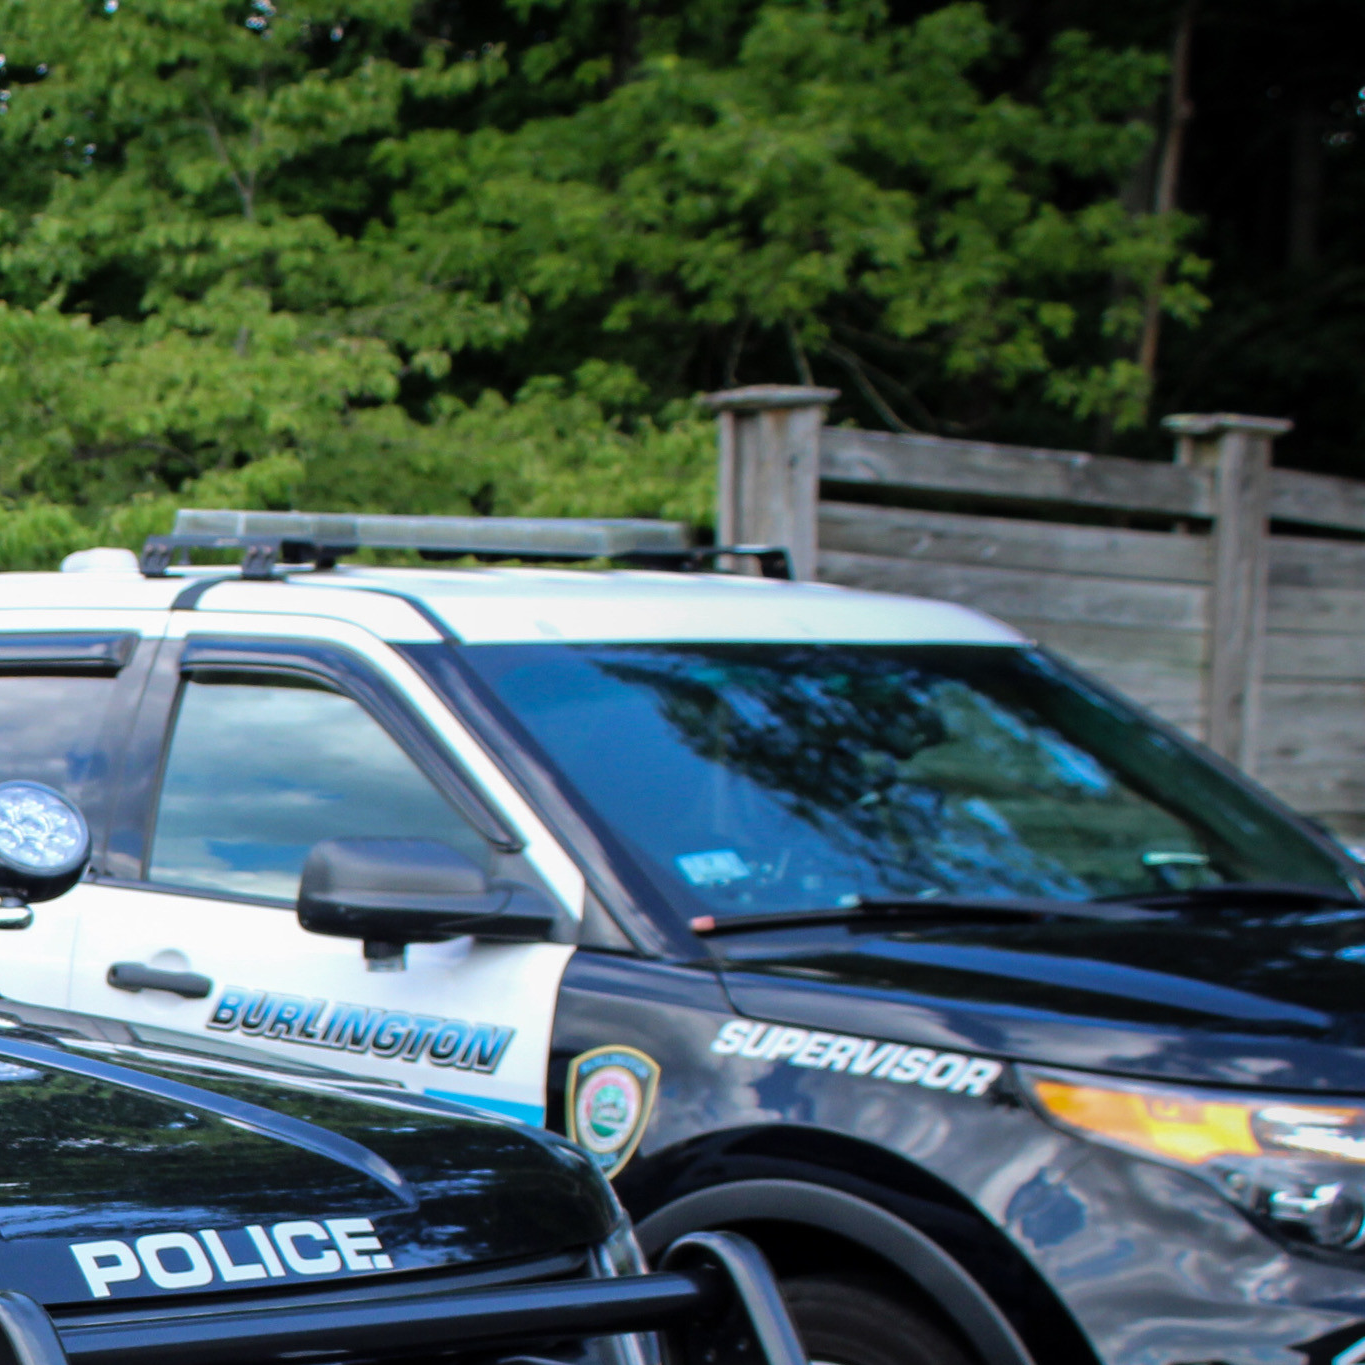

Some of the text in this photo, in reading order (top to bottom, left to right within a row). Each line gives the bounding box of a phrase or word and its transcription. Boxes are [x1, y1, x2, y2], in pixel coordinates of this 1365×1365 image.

[205, 985, 516, 1074] BURLINGTON
[710, 1018, 1003, 1097] SUPERVISOR
[69, 1217, 395, 1298] POLICE
